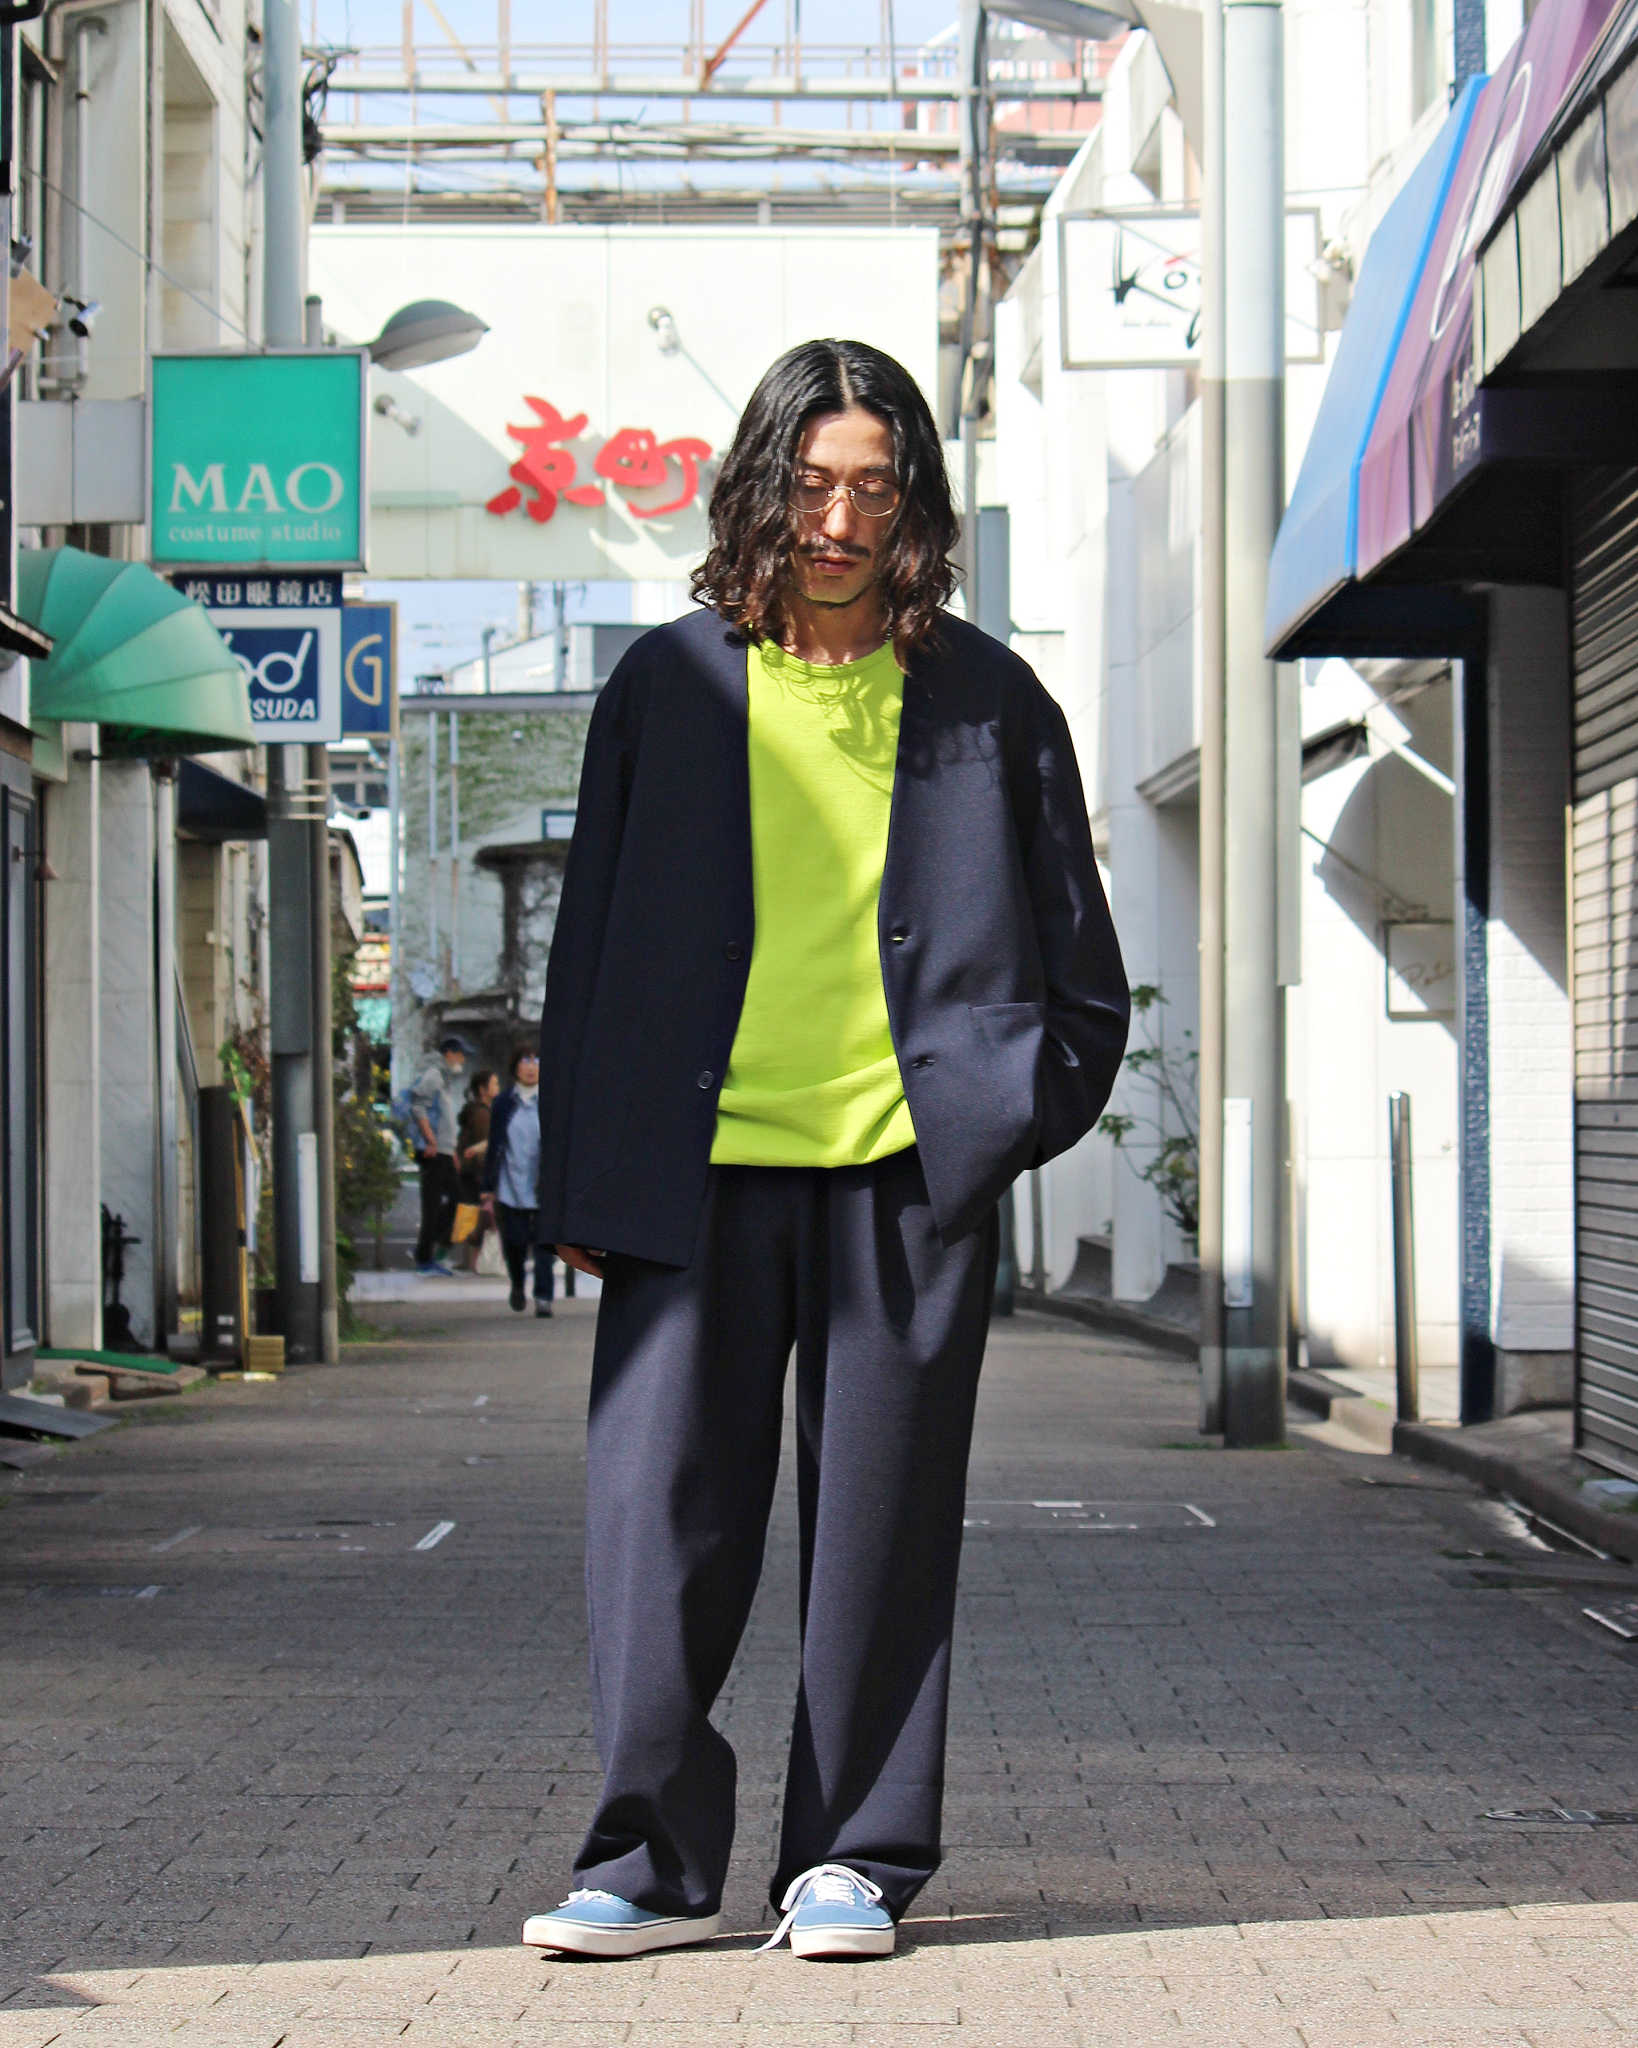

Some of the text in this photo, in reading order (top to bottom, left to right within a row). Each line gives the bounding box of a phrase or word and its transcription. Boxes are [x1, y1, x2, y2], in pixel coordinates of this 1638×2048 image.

[168, 462, 344, 514] MAO
[168, 520, 341, 543] costume studio
[184, 579, 333, 606] 松田眼鏡店
